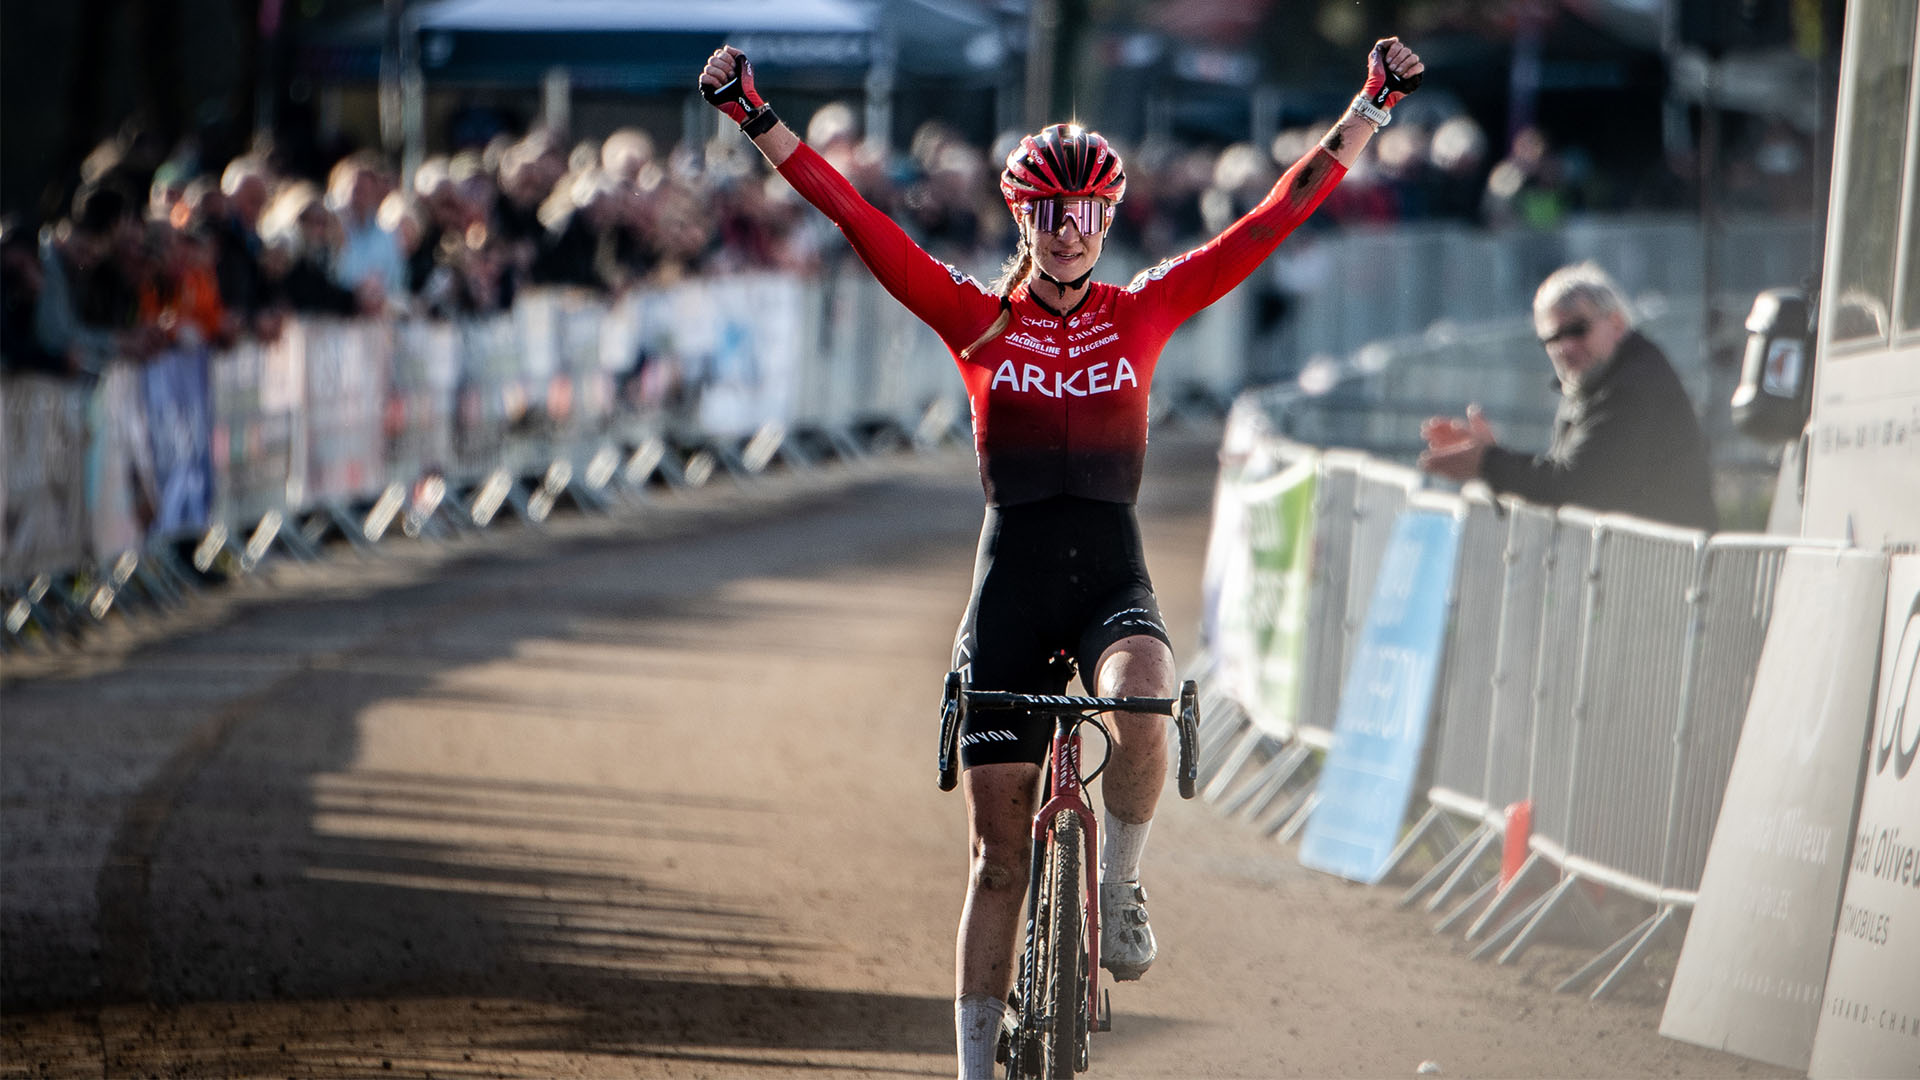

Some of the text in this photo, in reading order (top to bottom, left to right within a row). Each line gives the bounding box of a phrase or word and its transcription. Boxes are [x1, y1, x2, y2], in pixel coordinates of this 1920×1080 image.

[1068, 321, 1114, 342] CANYON
[1004, 331, 1061, 355] JACQUELINE
[1081, 332, 1120, 353] LEGENDRE
[991, 357, 1138, 398] ARKEA
[960, 729, 1018, 748] ANYON
